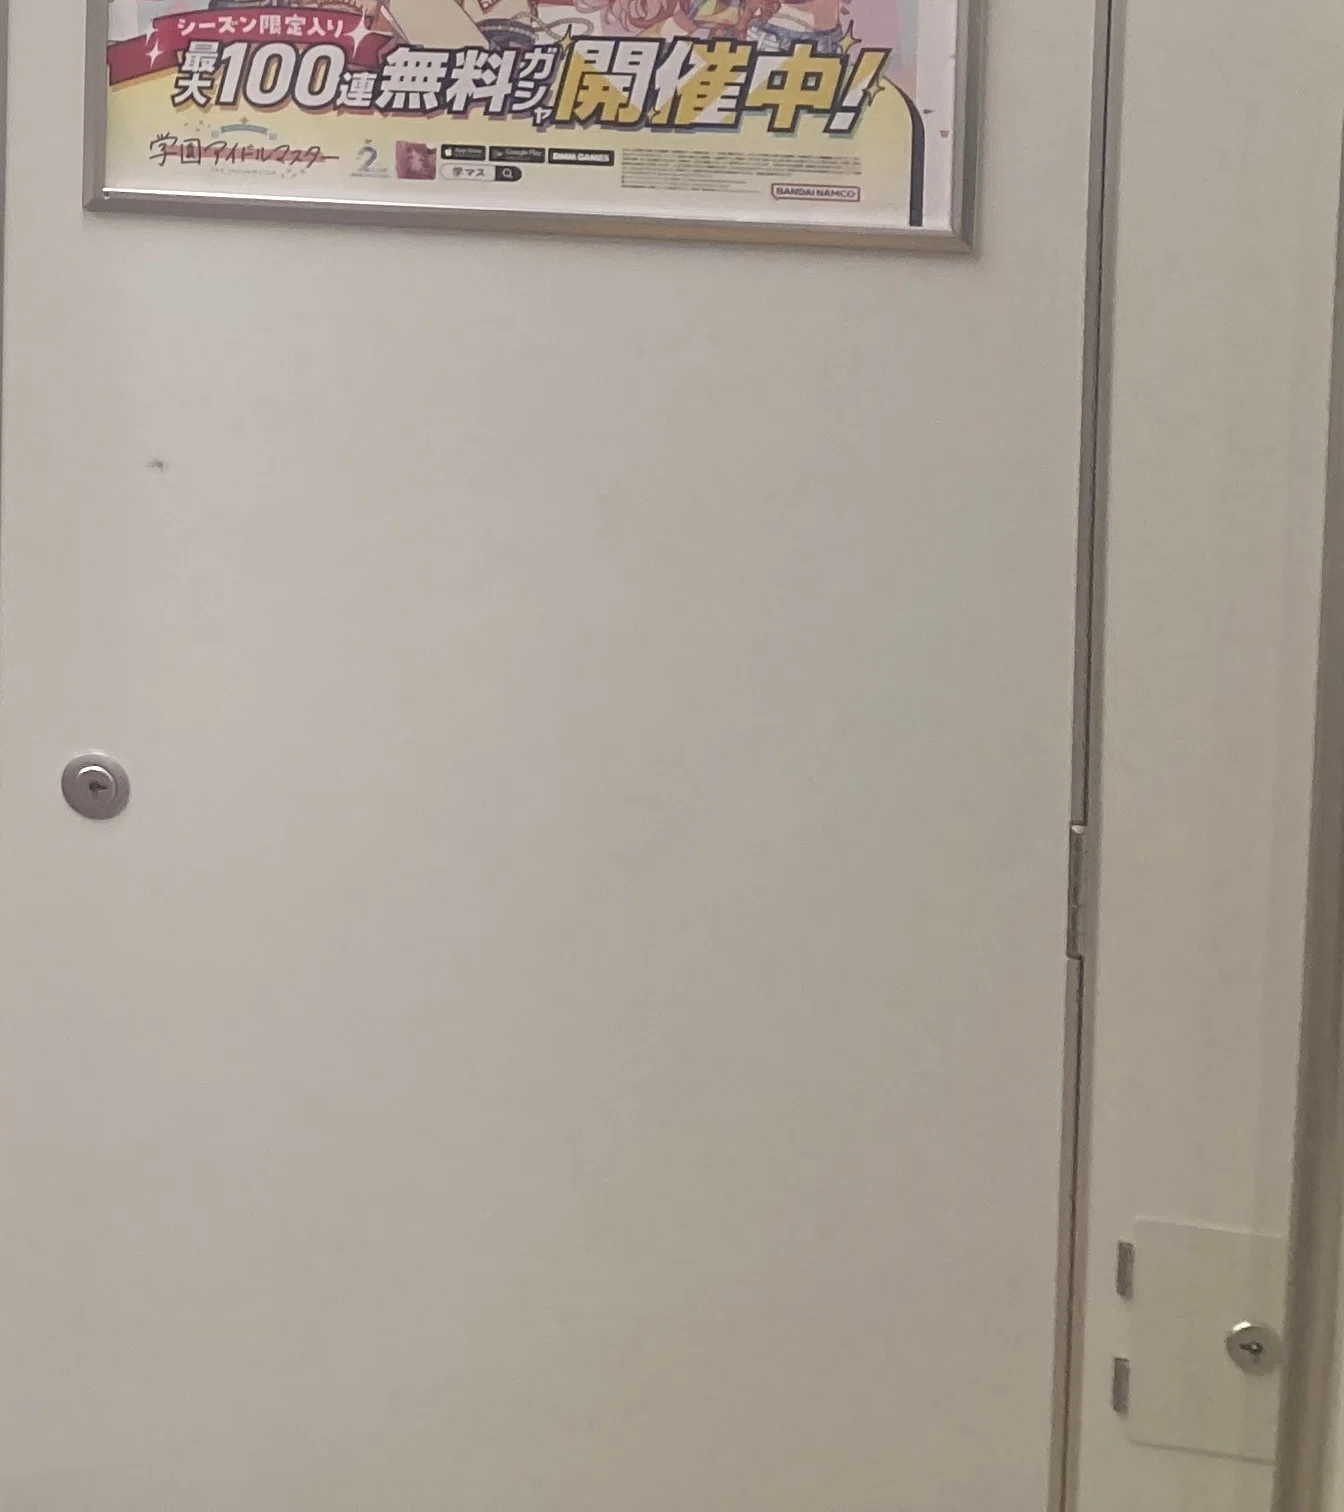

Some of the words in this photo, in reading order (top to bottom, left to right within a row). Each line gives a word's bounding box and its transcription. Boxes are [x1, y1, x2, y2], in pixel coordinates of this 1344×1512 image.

[177, 14, 345, 39] シーズン限定入り
